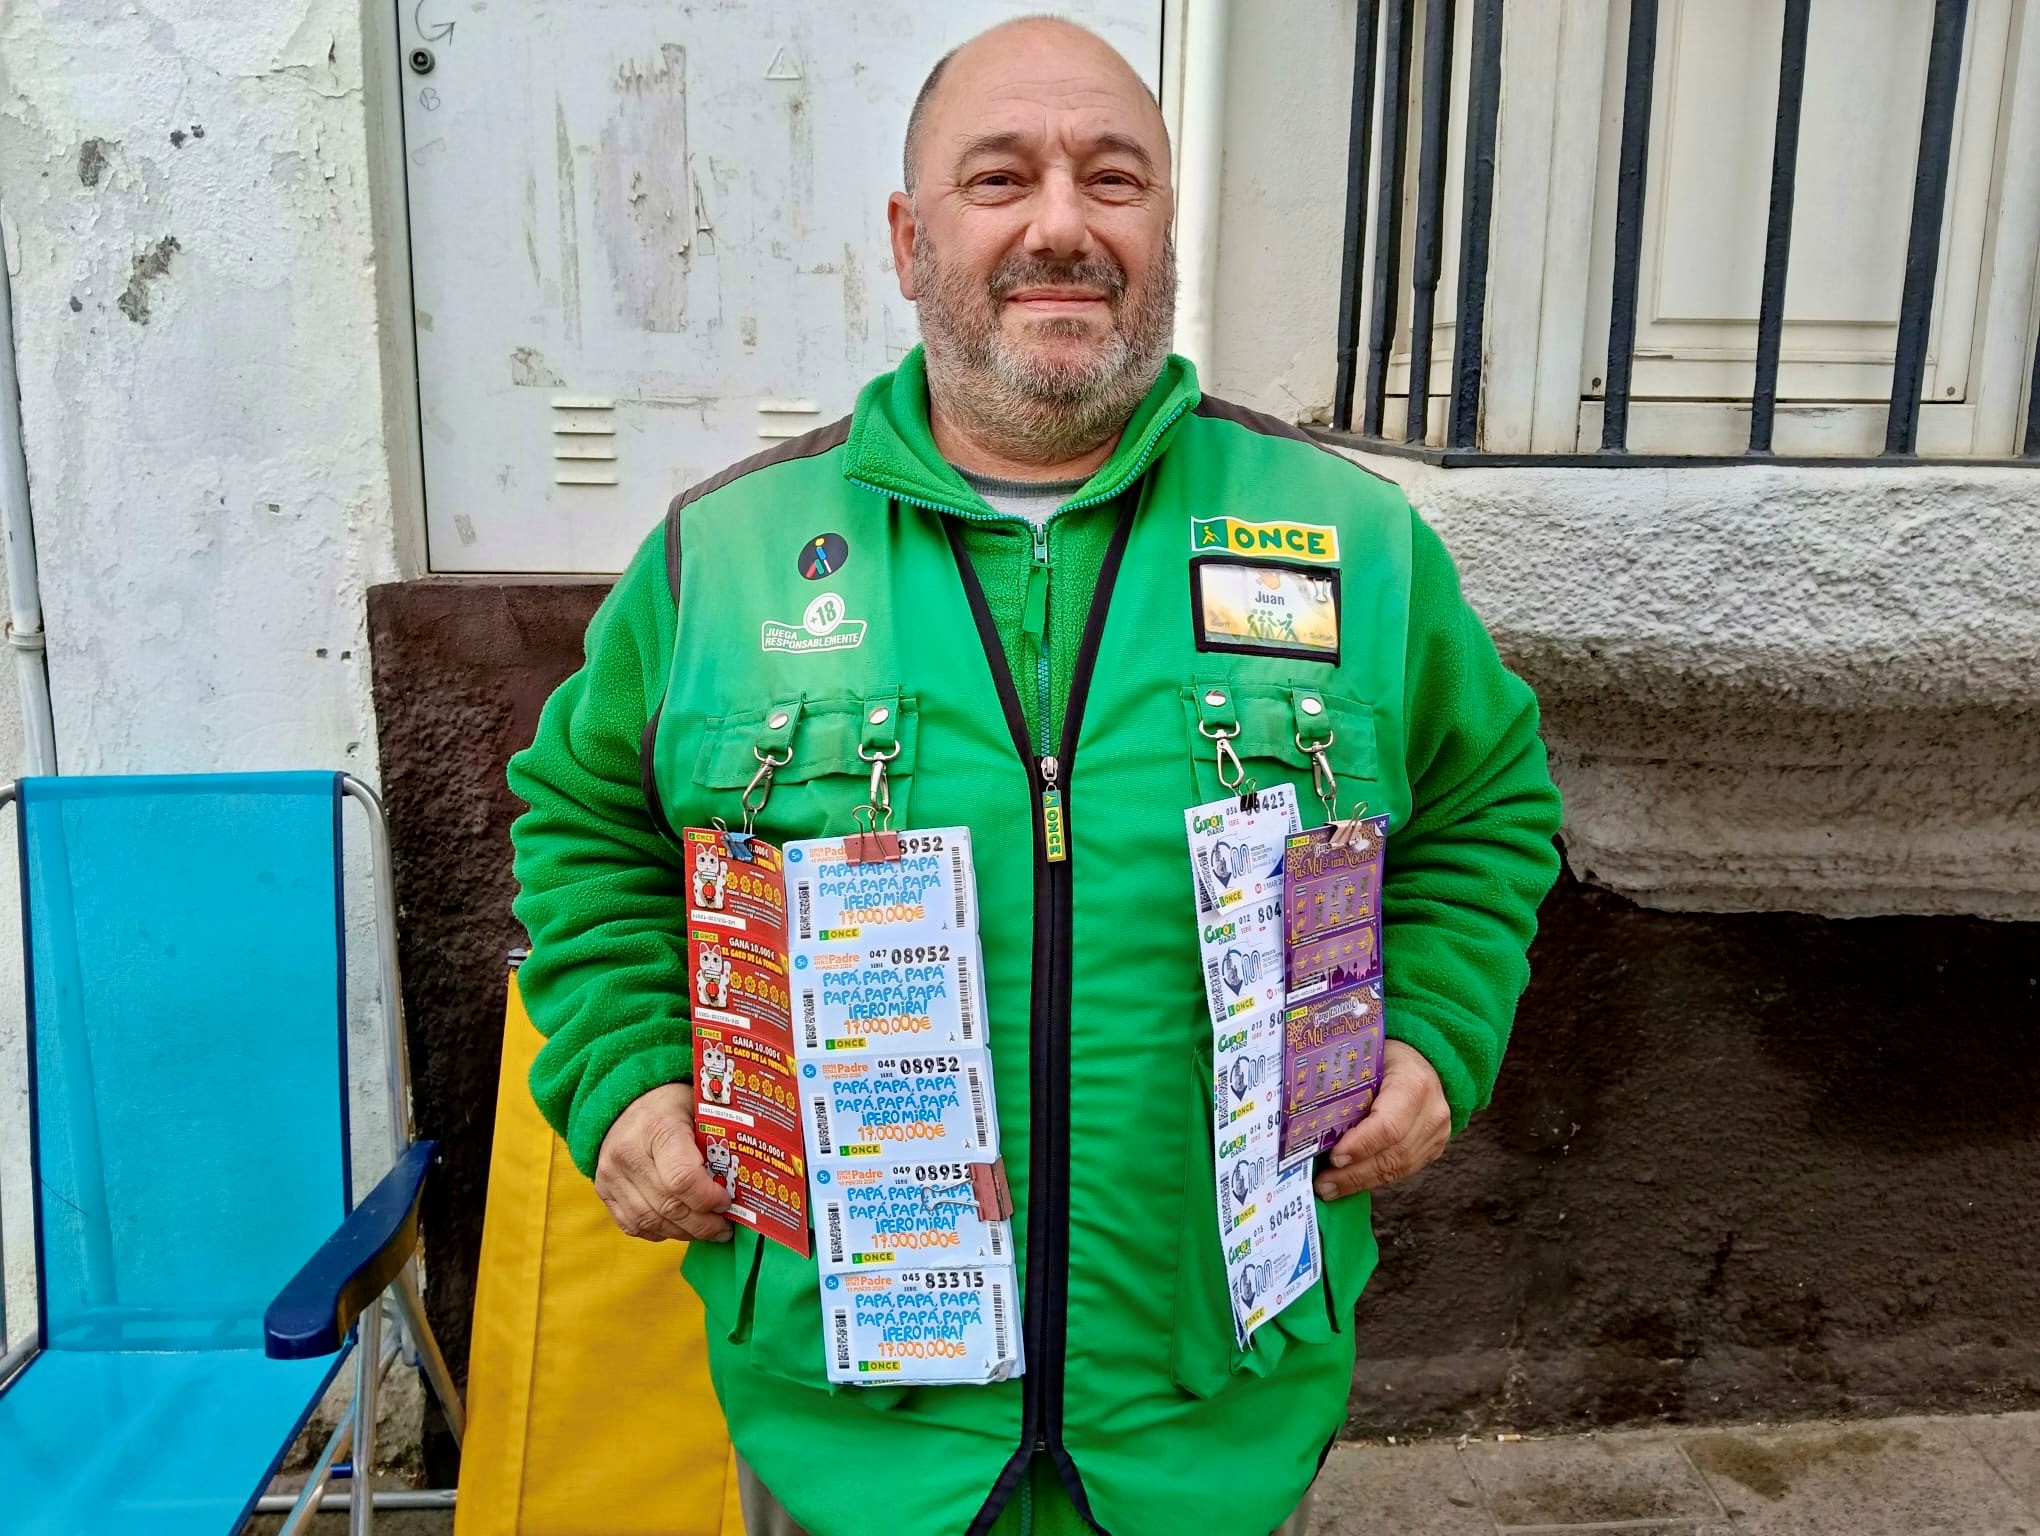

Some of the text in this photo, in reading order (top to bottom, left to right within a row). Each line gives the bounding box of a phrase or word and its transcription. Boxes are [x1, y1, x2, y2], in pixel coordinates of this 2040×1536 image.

[1235, 528, 1326, 555] ONCE
[1255, 591, 1285, 606] Juan
[810, 601, 837, 626] +18
[766, 628, 798, 640] JUEGA
[765, 633, 858, 649] RESPONSABLEMENTE
[1047, 810, 1060, 855] ONCE
[1207, 827, 1224, 836] DIARIO
[898, 836, 943, 855] 8952
[1303, 856, 1324, 877] Mil
[1332, 859, 1344, 867] una
[1341, 848, 1377, 868] Noches
[1225, 892, 1241, 903] ONCE
[1258, 902, 1282, 923] 804
[830, 930, 858, 938] ONCE
[1219, 934, 1236, 945] DIARIO
[729, 938, 749, 949] GANA
[721, 947, 729, 955] EL
[870, 945, 950, 965] 047 08952
[829, 953, 860, 963] Padre
[1235, 998, 1254, 1011] ONCE
[1293, 1008, 1306, 1017] ONCE
[1303, 1027, 1324, 1047] Mil
[1332, 1026, 1344, 1036] una
[1340, 1013, 1377, 1033] Noches
[733, 1036, 754, 1049] GANA
[837, 1039, 865, 1048] ONCE
[725, 1045, 733, 1053] EL
[837, 1063, 869, 1073] Padre
[900, 1056, 960, 1074] 08952
[1238, 1103, 1254, 1117] ONCE
[1250, 1123, 1261, 1134] 014
[729, 1141, 737, 1149] EL
[737, 1132, 757, 1146] GANA
[851, 1145, 879, 1154] ONCE
[852, 1169, 883, 1179] Padre
[893, 1166, 910, 1175] 049
[1240, 1205, 1256, 1221] ONCE
[1270, 1196, 1302, 1231] 80423
[864, 1252, 893, 1261] ONCE
[861, 1275, 892, 1286] Padre
[902, 1272, 984, 1289] 045 83315
[1248, 1308, 1264, 1329] ONCE
[870, 1362, 899, 1370] ONCE
